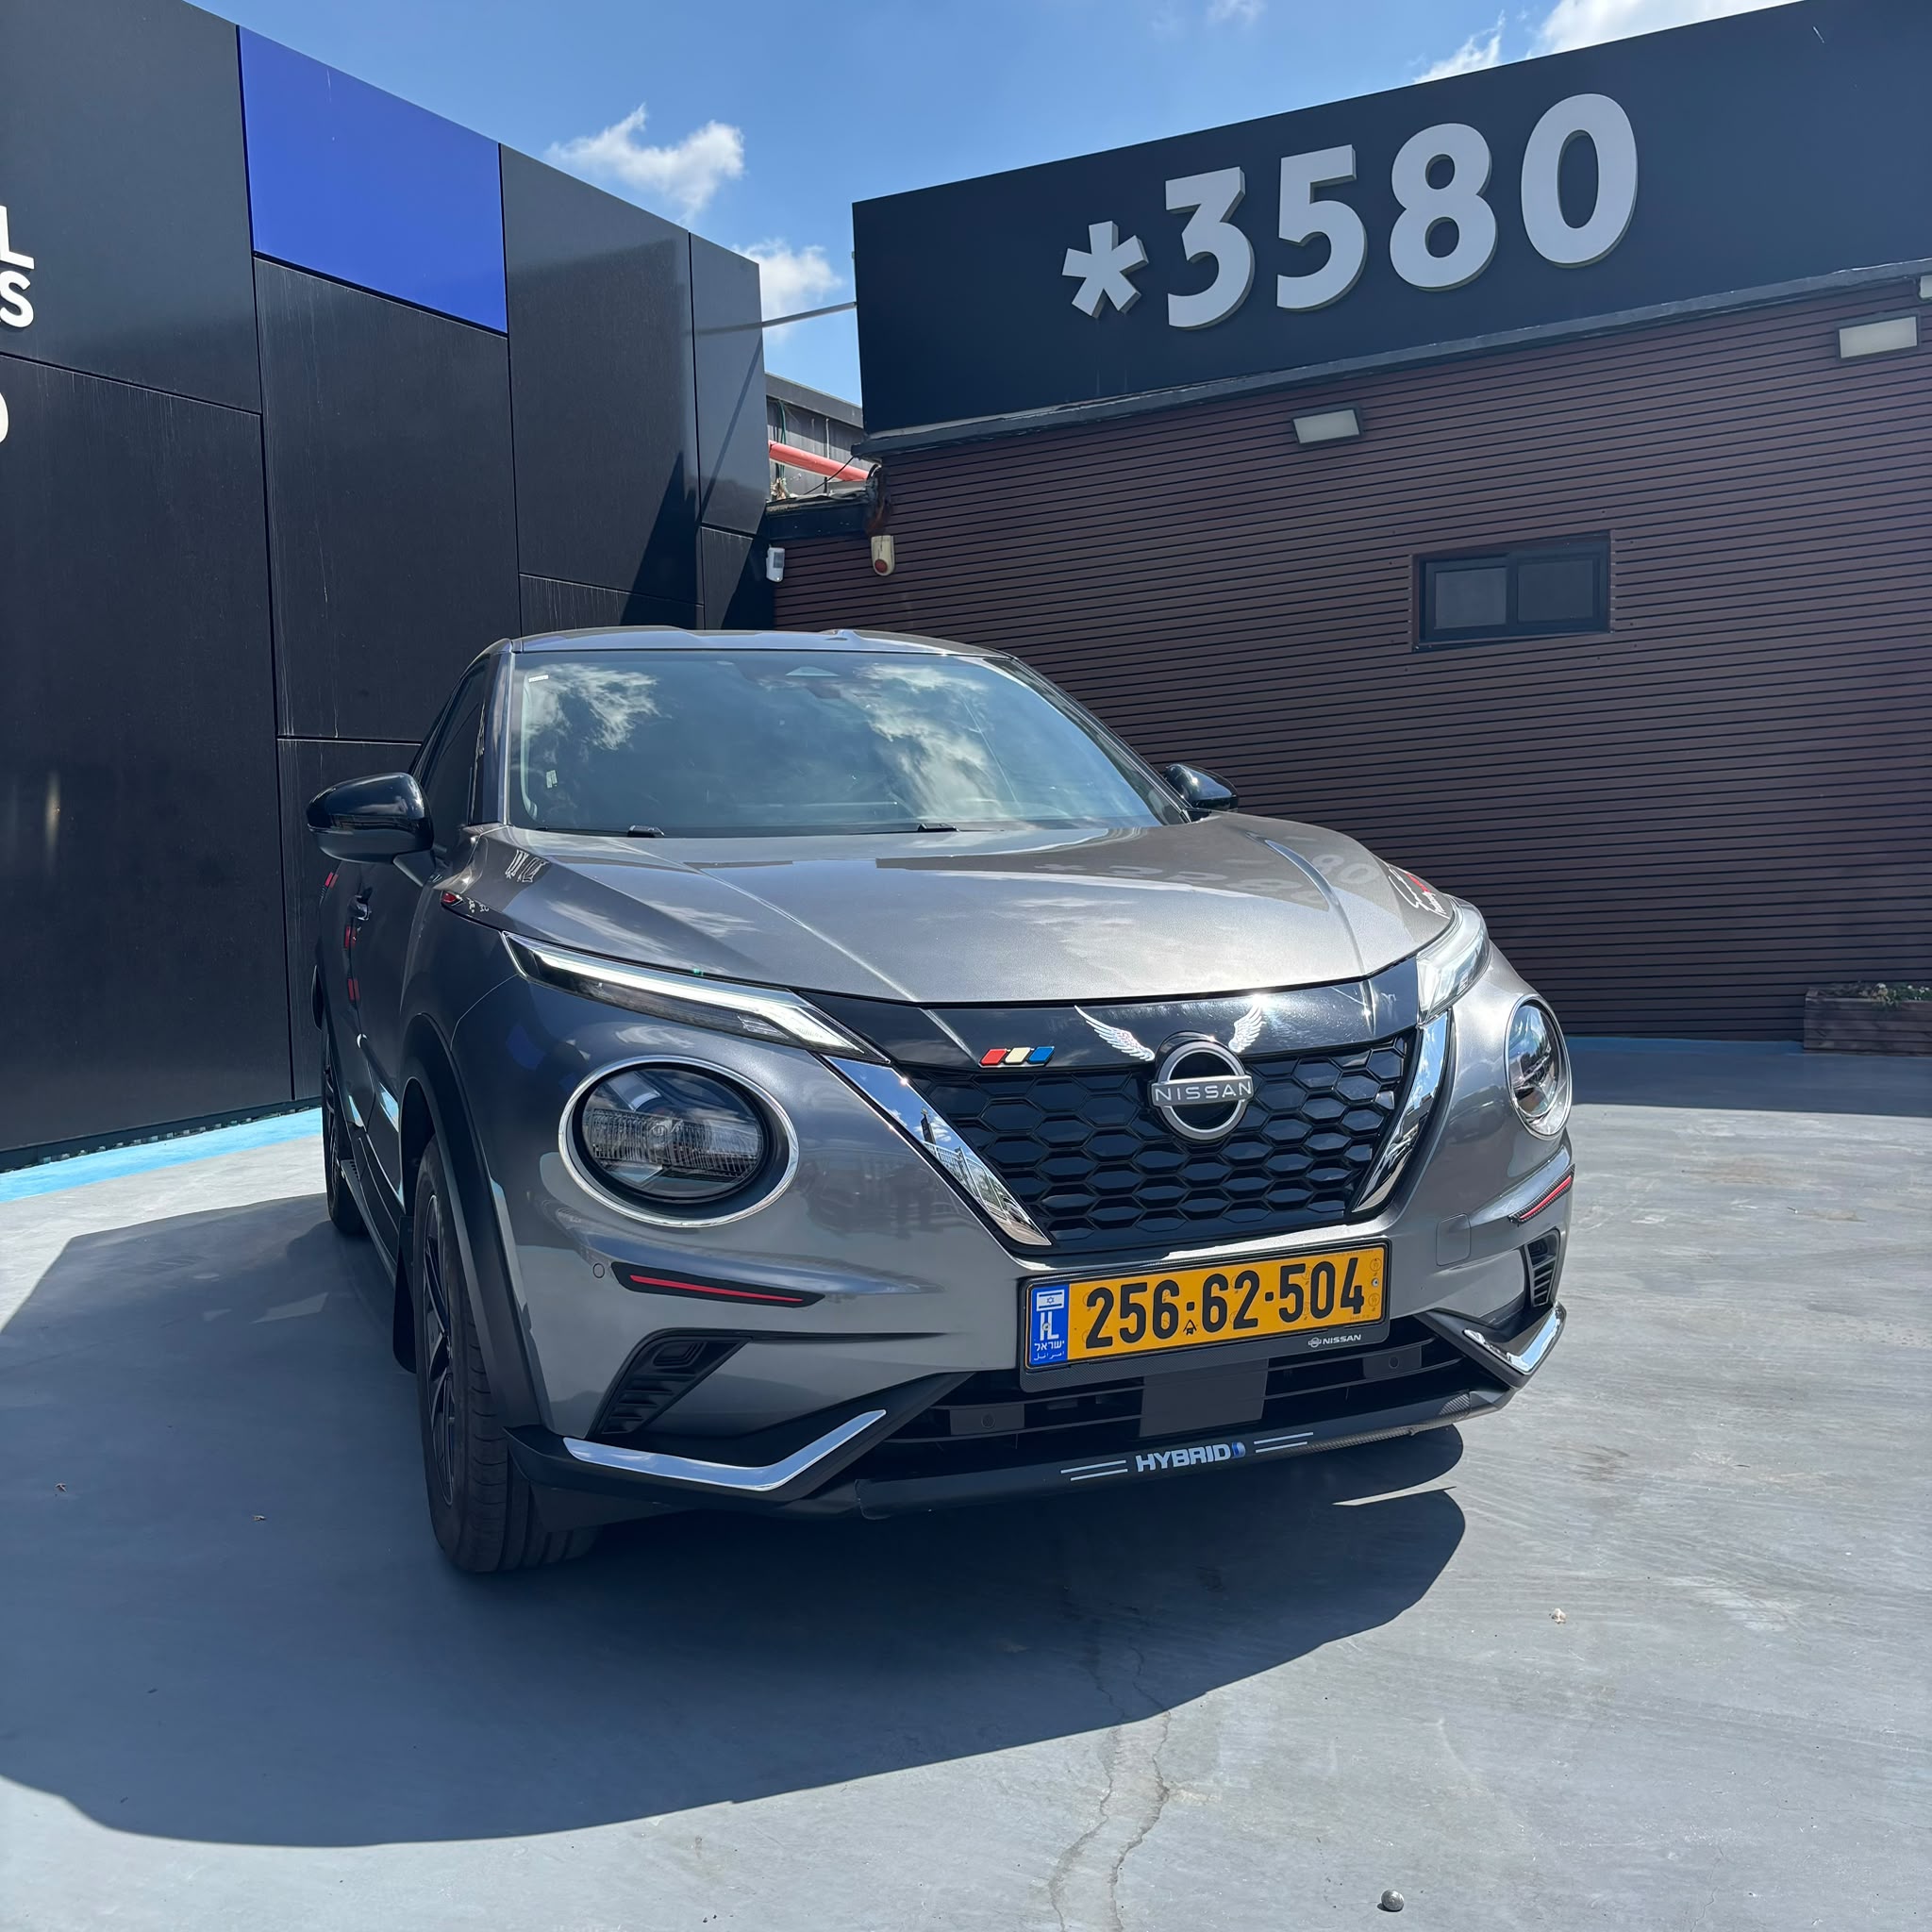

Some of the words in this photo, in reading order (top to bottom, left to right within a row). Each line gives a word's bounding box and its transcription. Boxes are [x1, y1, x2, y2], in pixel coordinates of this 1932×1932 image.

[1154, 1080, 1252, 1102] NISSAN
[1040, 1310, 1059, 1341] IL
[1034, 1340, 1065, 1352] ישראל
[1322, 1333, 1362, 1345] NISSAN
[1135, 1443, 1231, 1473] HYBRID
